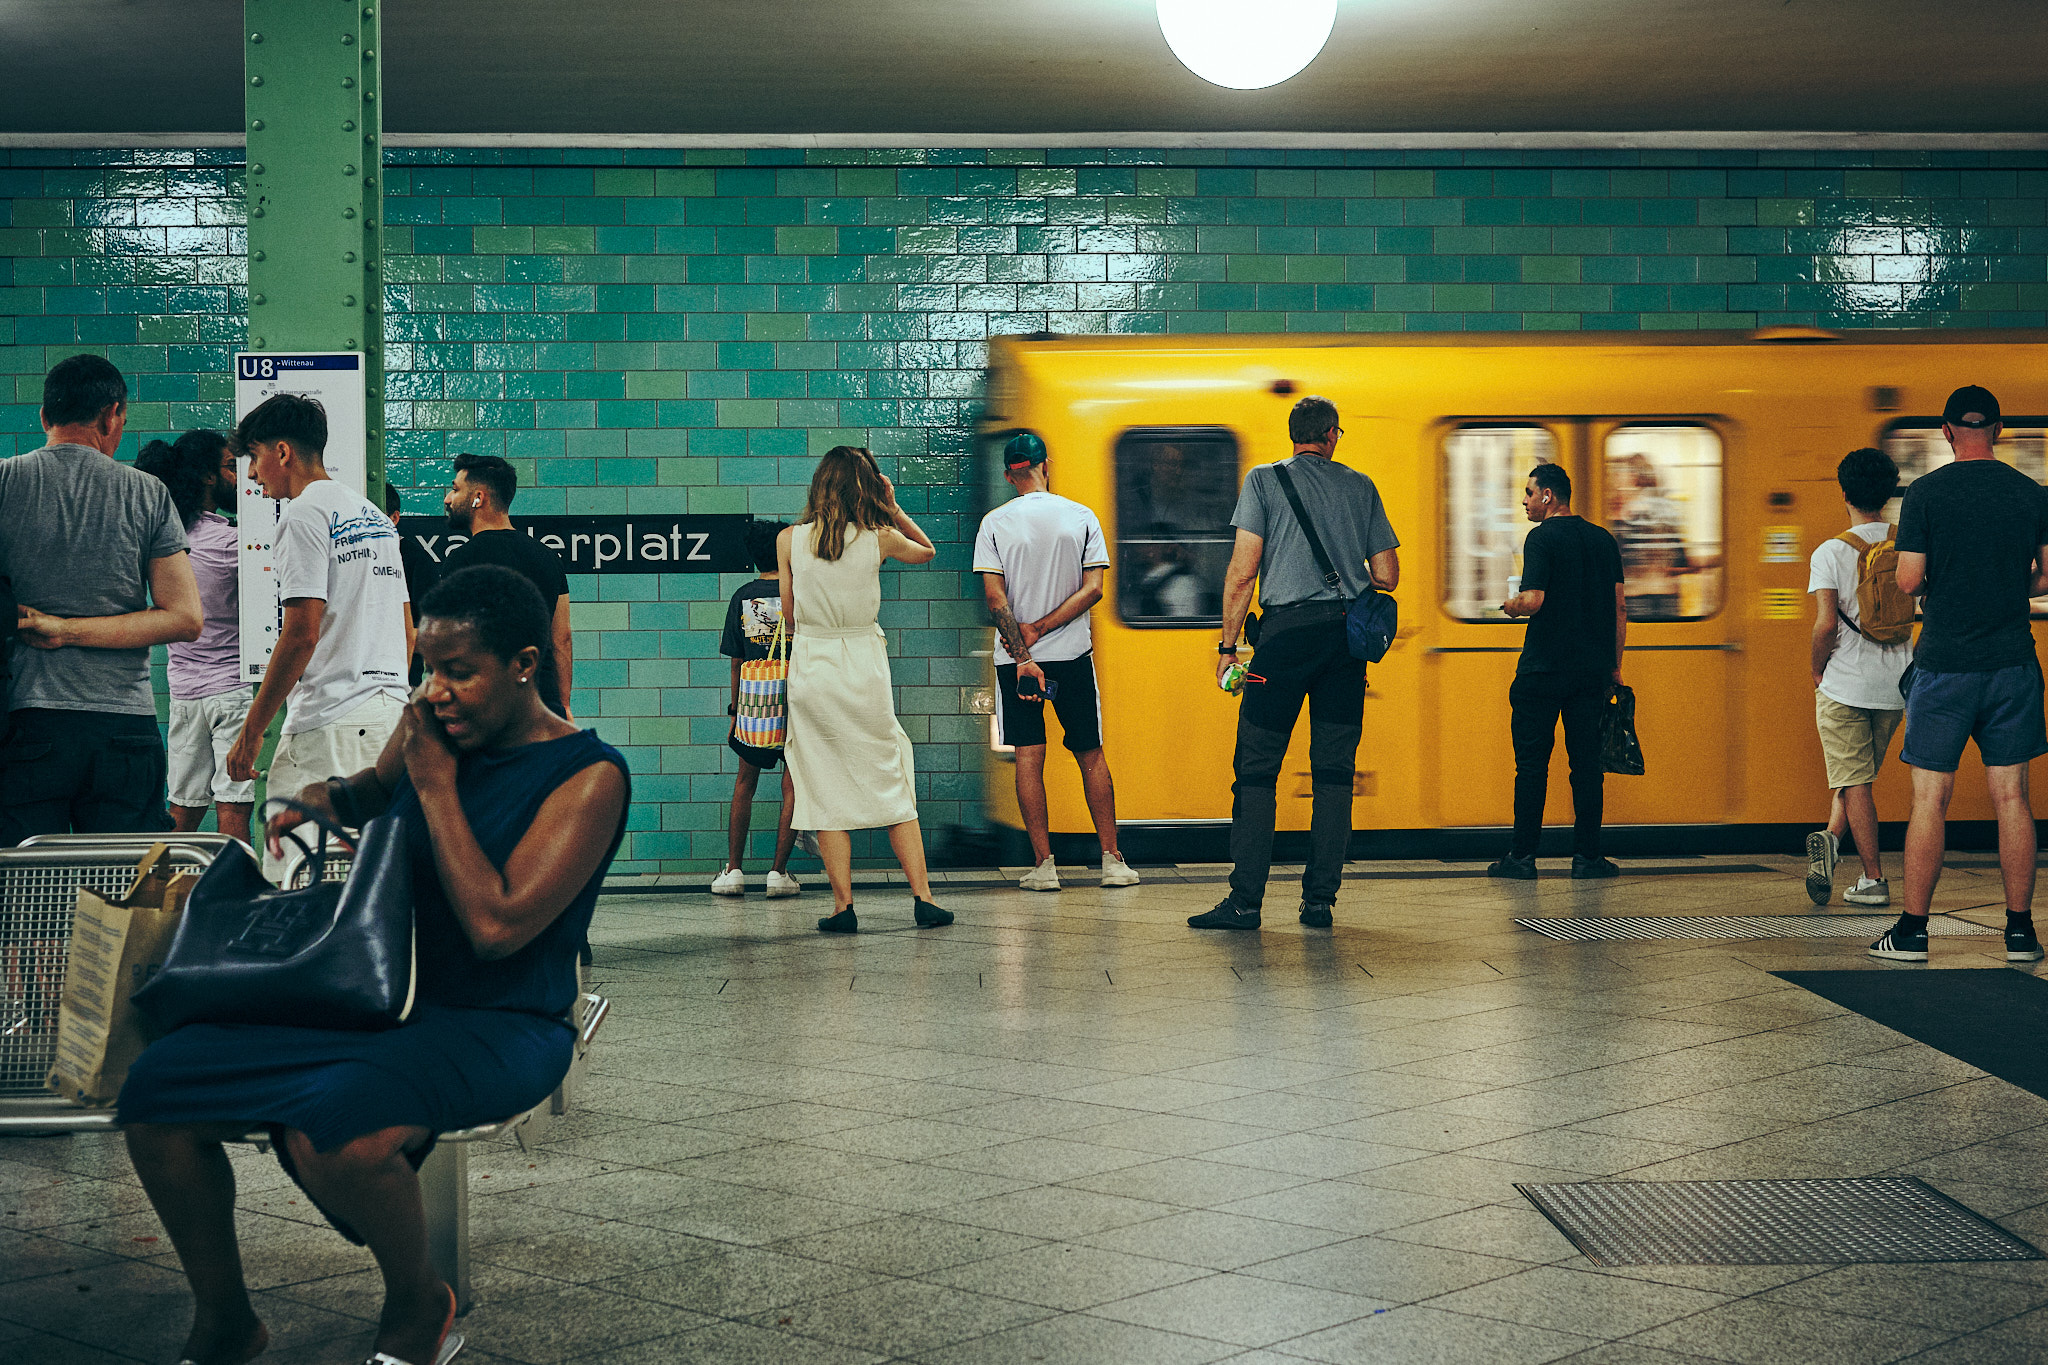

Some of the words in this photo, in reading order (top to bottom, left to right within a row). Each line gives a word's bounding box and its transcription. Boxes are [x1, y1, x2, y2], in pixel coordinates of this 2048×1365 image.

[242, 358, 274, 378] U8
[281, 359, 314, 367] Wittenau
[399, 523, 711, 569] xaerplatz
